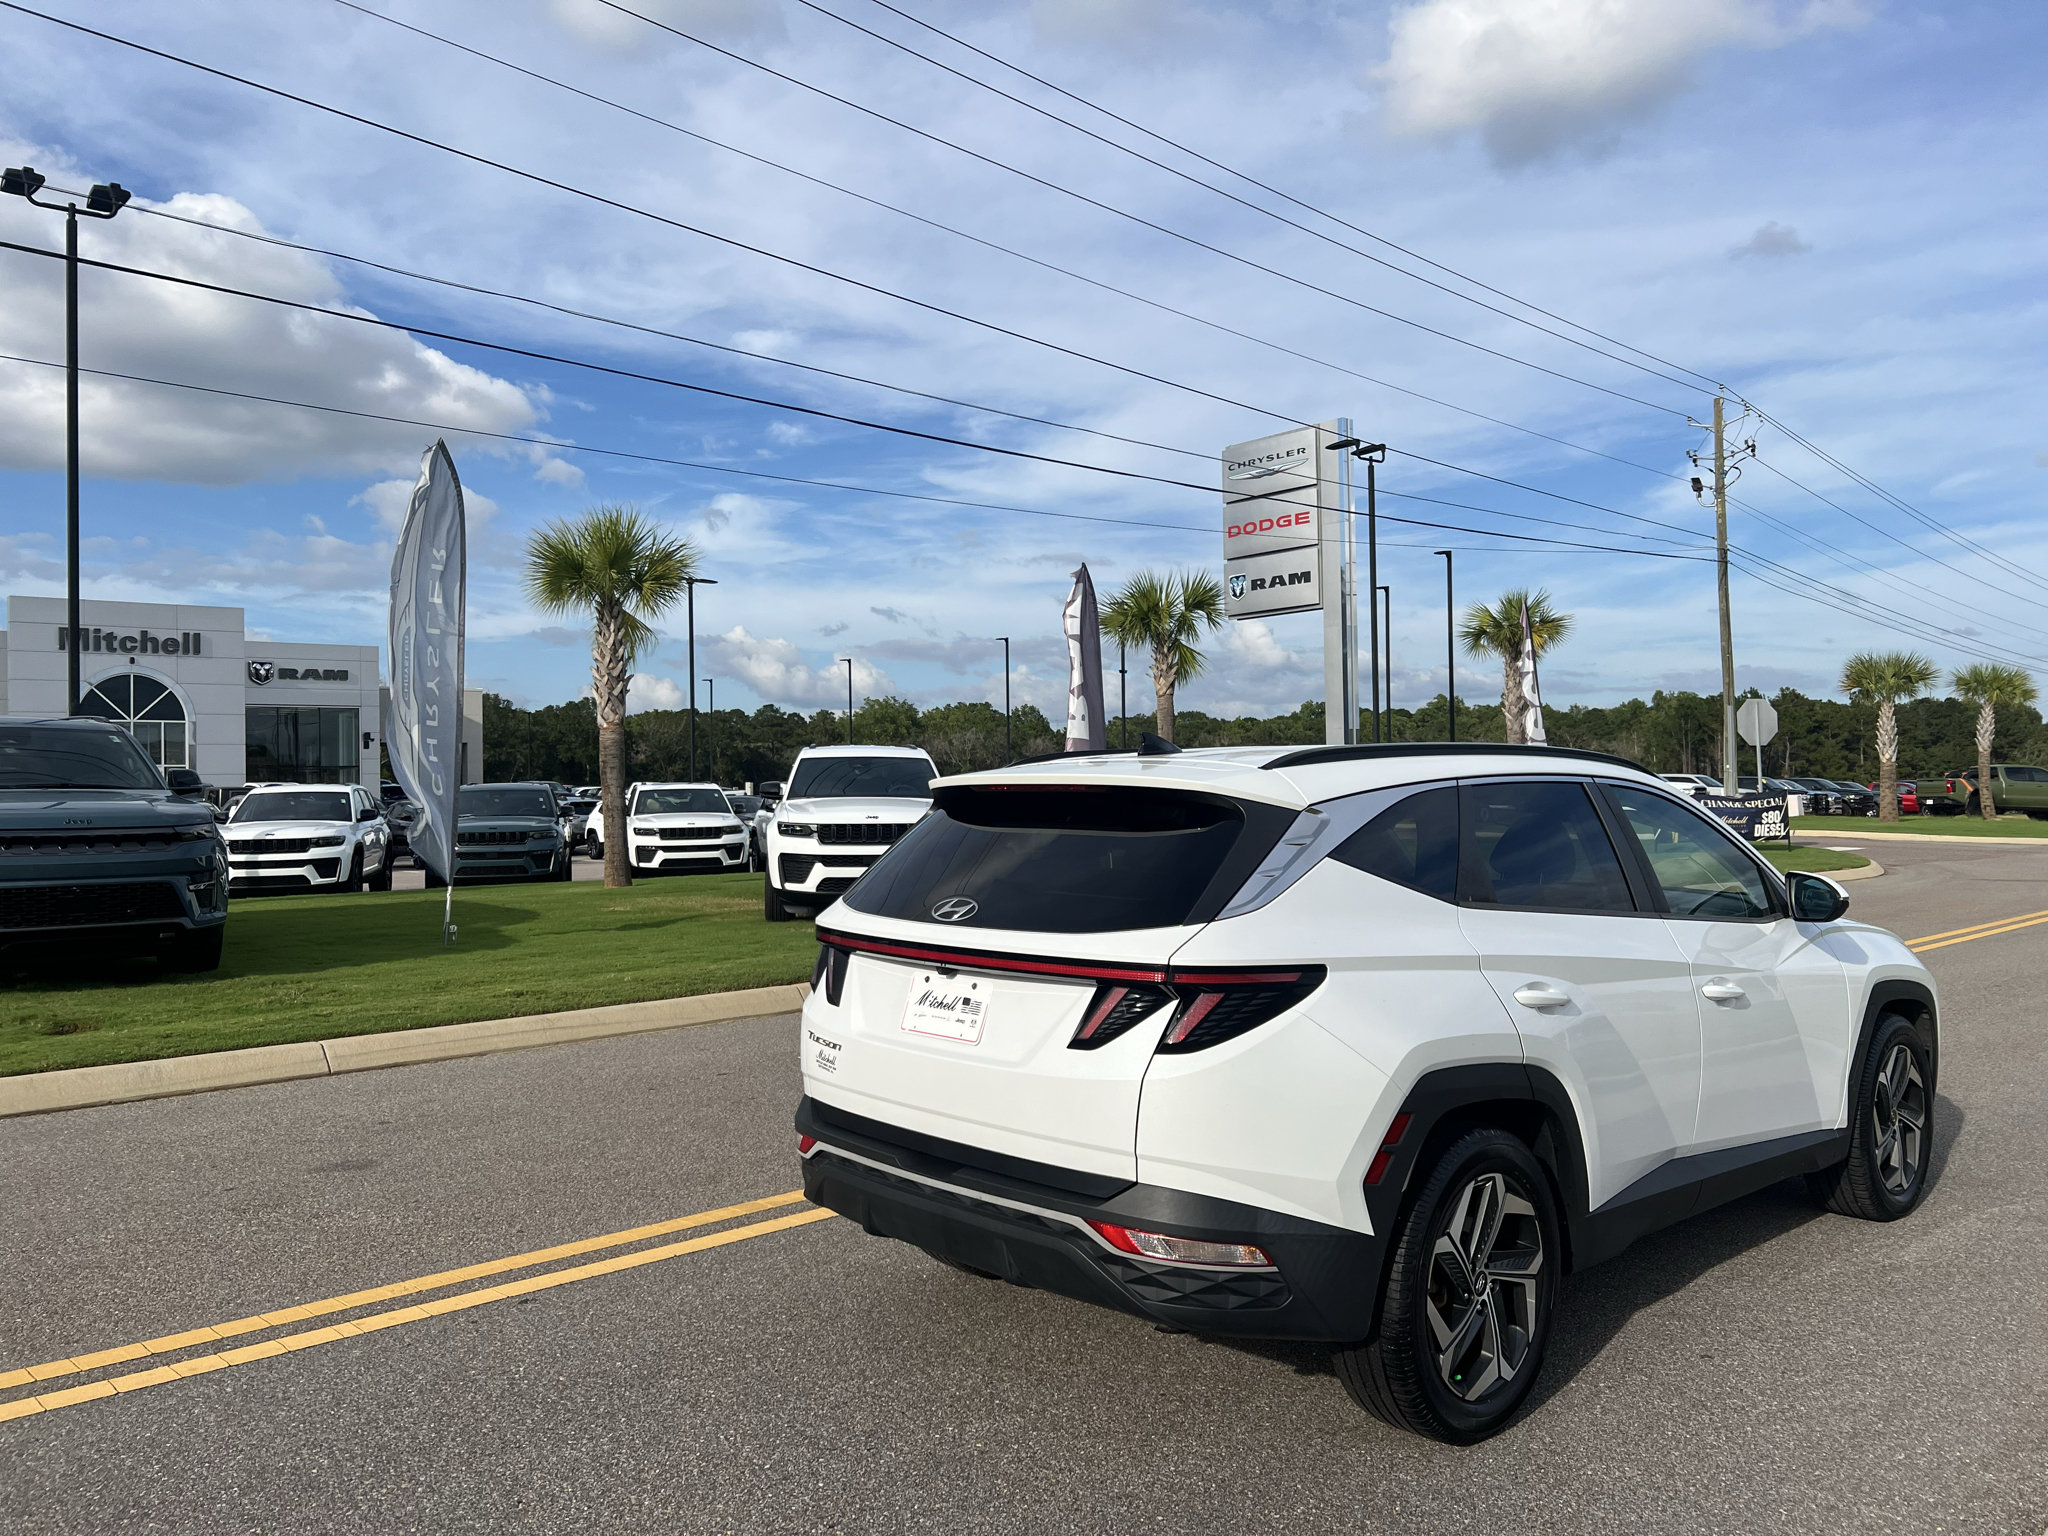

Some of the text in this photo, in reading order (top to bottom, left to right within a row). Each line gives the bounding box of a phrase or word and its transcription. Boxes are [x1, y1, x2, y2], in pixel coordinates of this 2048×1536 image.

[1228, 447, 1306, 471] CHRYSLER
[1227, 511, 1310, 538] DODGE
[1251, 570, 1311, 591] RAM
[58, 626, 201, 656] Mitchell
[278, 667, 349, 682] RAM
[64, 817, 93, 826] Jeep
[1761, 810, 1781, 824] $80
[1754, 823, 1786, 837] DIESEL
[914, 989, 962, 1012] Mitchell
